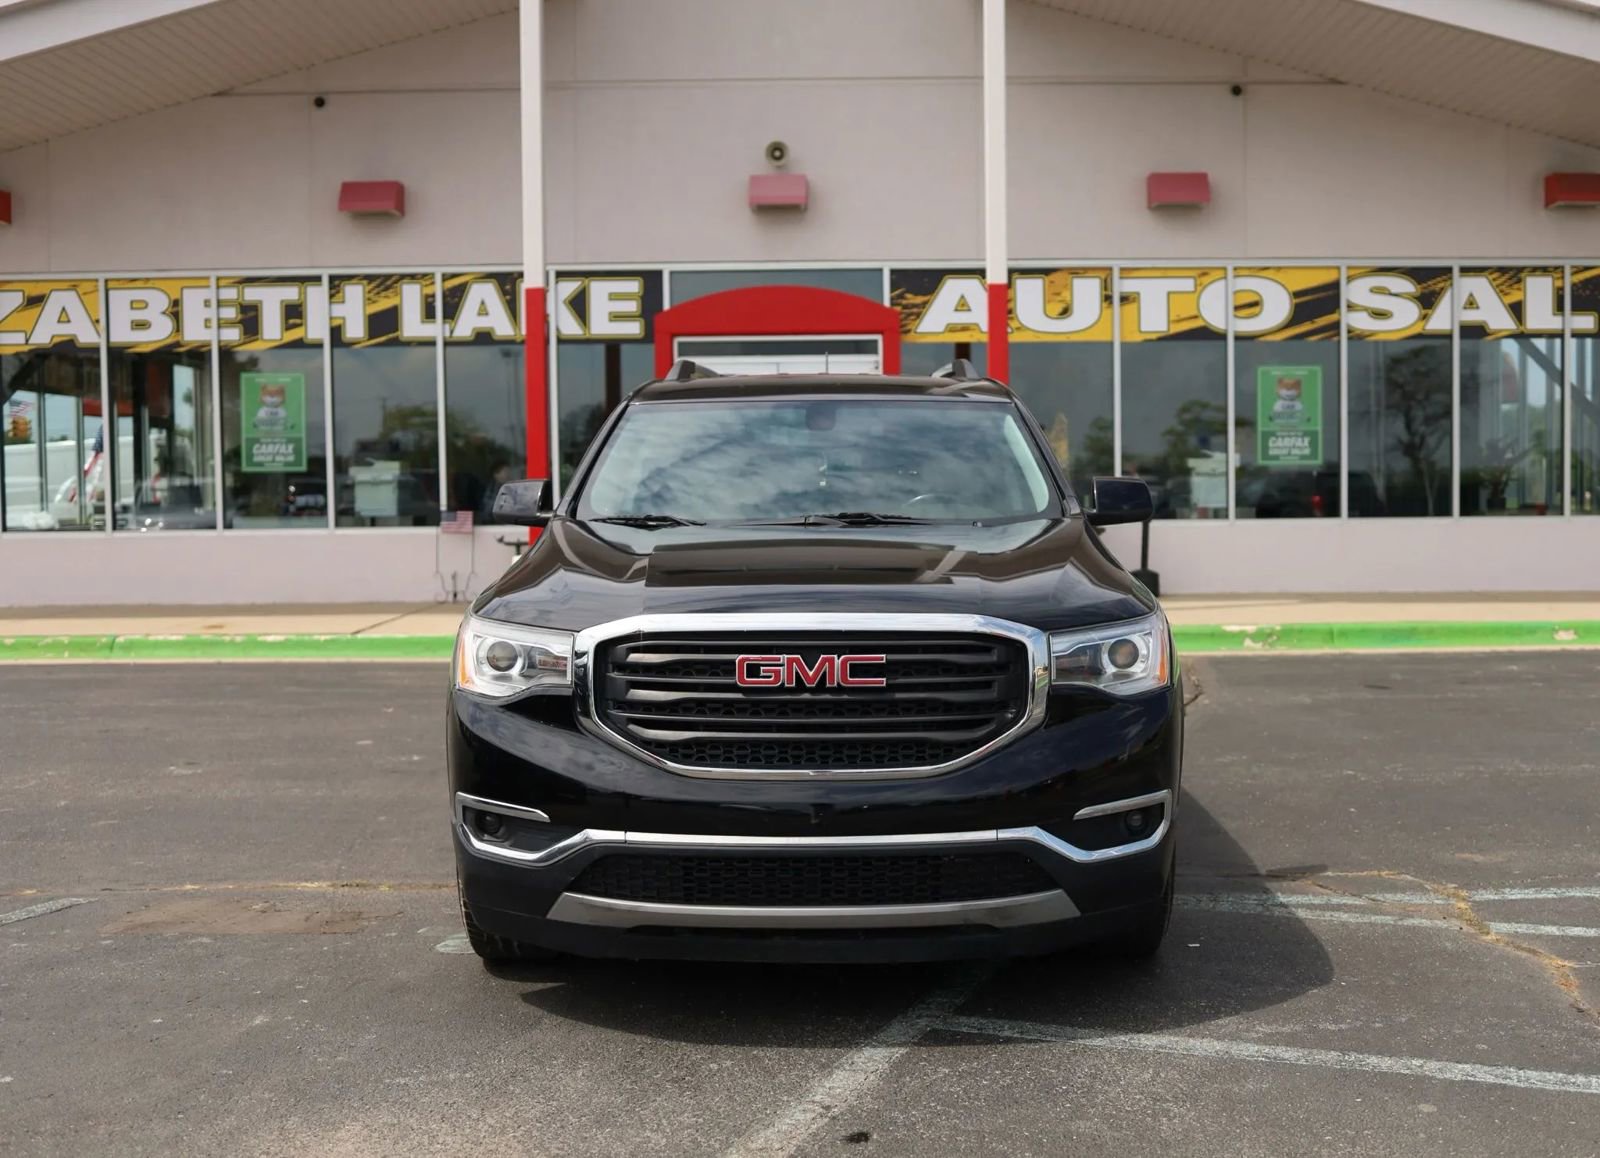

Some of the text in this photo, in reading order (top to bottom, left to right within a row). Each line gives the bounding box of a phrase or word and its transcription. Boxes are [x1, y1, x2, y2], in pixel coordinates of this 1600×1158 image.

[400, 277, 645, 342] LAKE
[913, 272, 1598, 335] AUTO SAL
[252, 443, 295, 454] CARFAX
[1268, 436, 1311, 448] CARFAX
[736, 654, 886, 687] GMC
